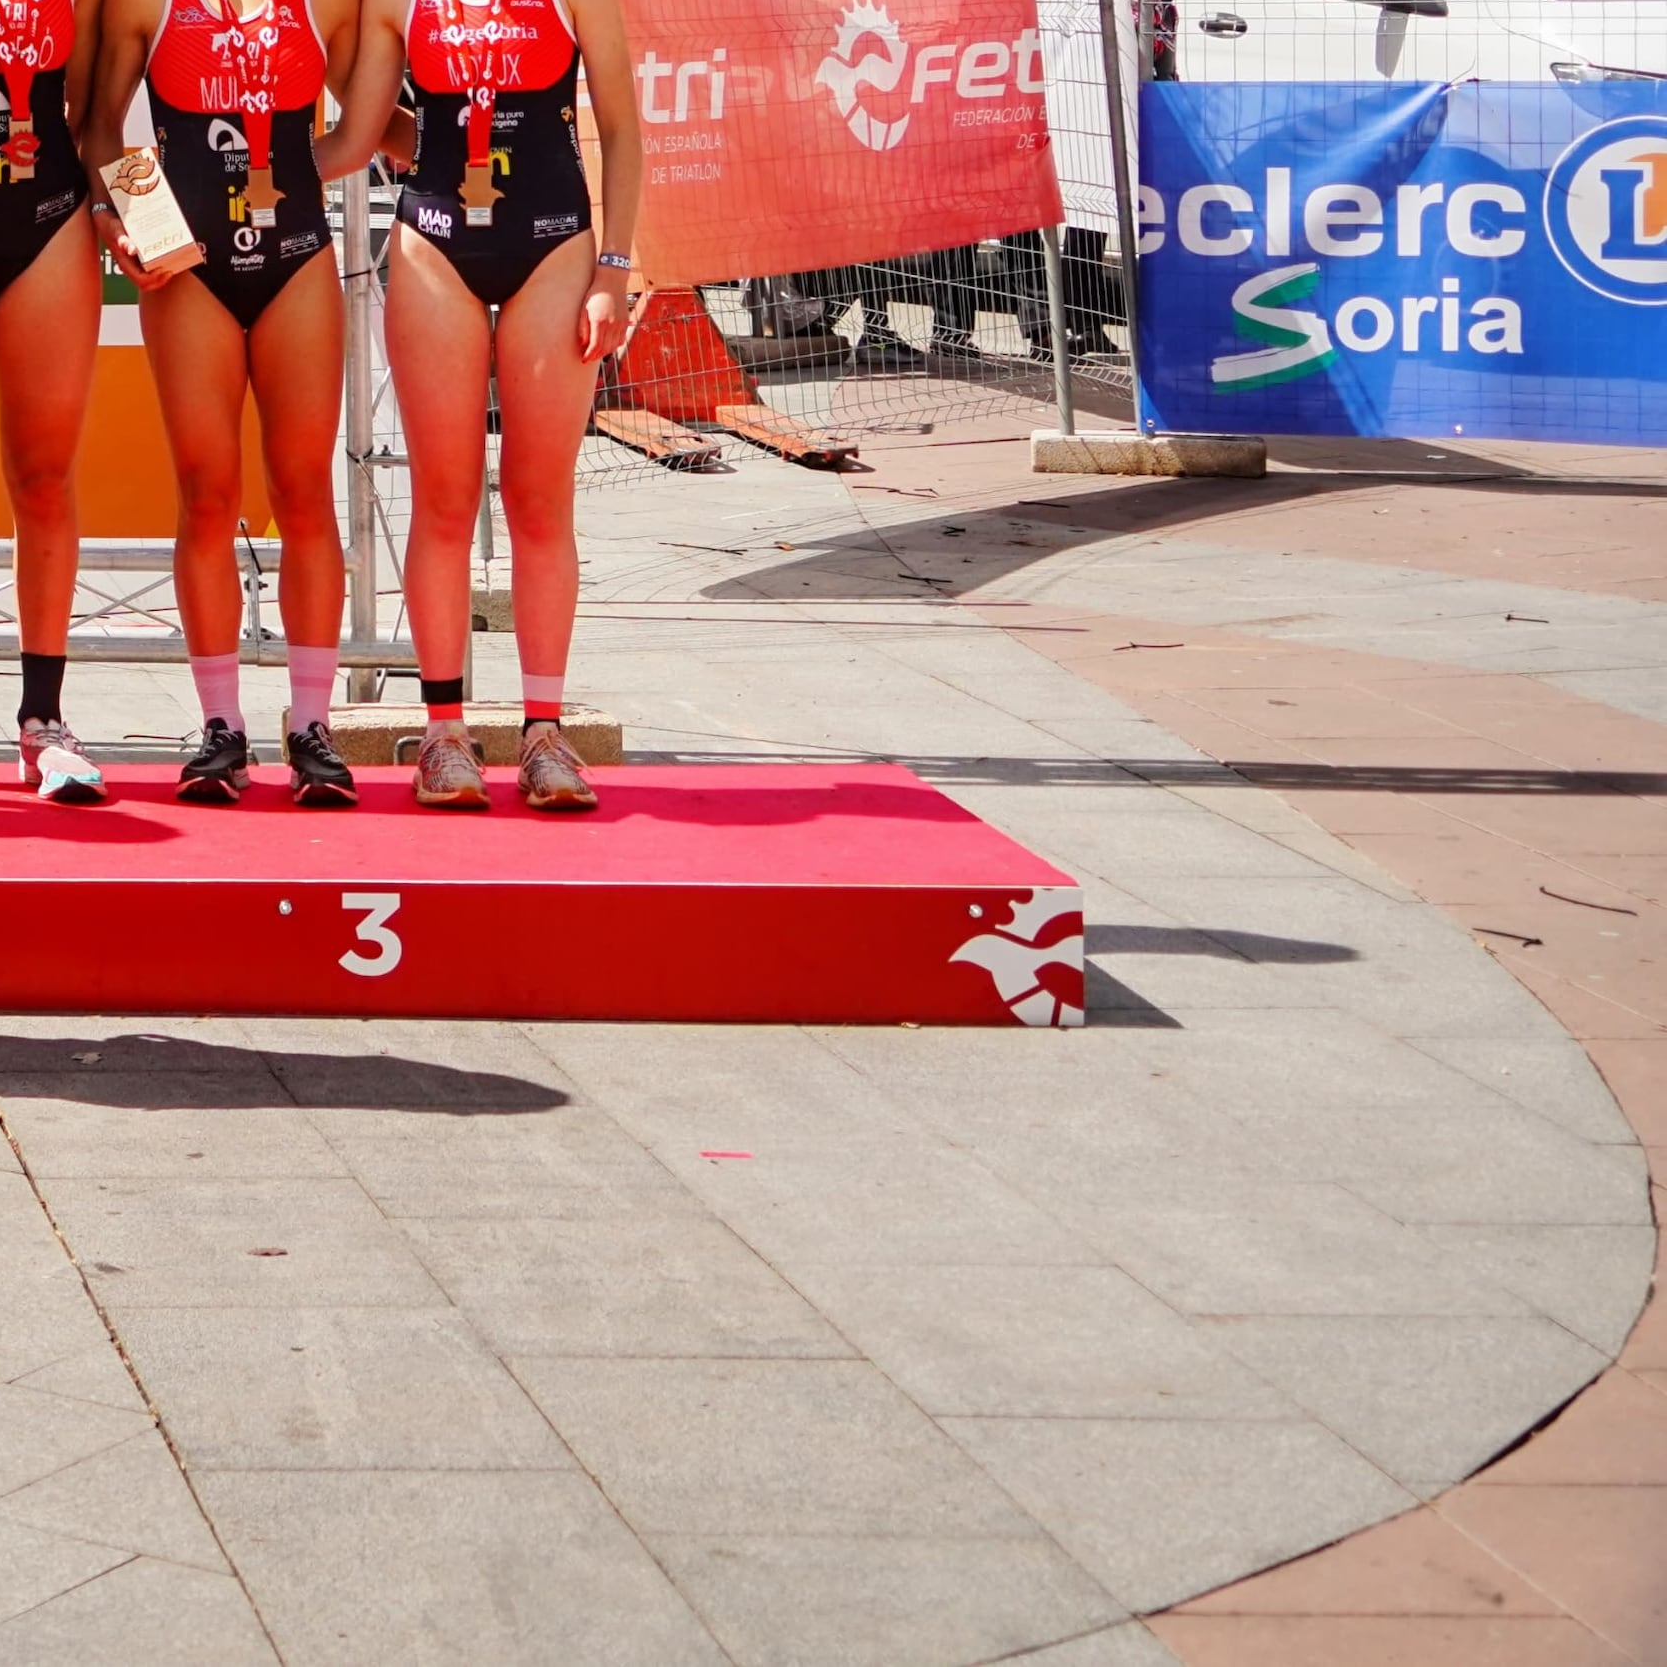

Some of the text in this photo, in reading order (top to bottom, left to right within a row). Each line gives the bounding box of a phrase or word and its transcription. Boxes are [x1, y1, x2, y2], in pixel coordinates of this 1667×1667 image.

[952, 104, 1035, 129] FEDERACIÓN
[664, 131, 722, 154] ESPAÑOLA
[1016, 132, 1036, 150] DE
[651, 161, 721, 185] DE TRIATLÓN
[418, 206, 453, 228] MAD
[533, 215, 579, 228] NOMADAC
[418, 222, 452, 239] CHAIN
[1211, 262, 1524, 395] Soria
[337, 891, 403, 977] 3
